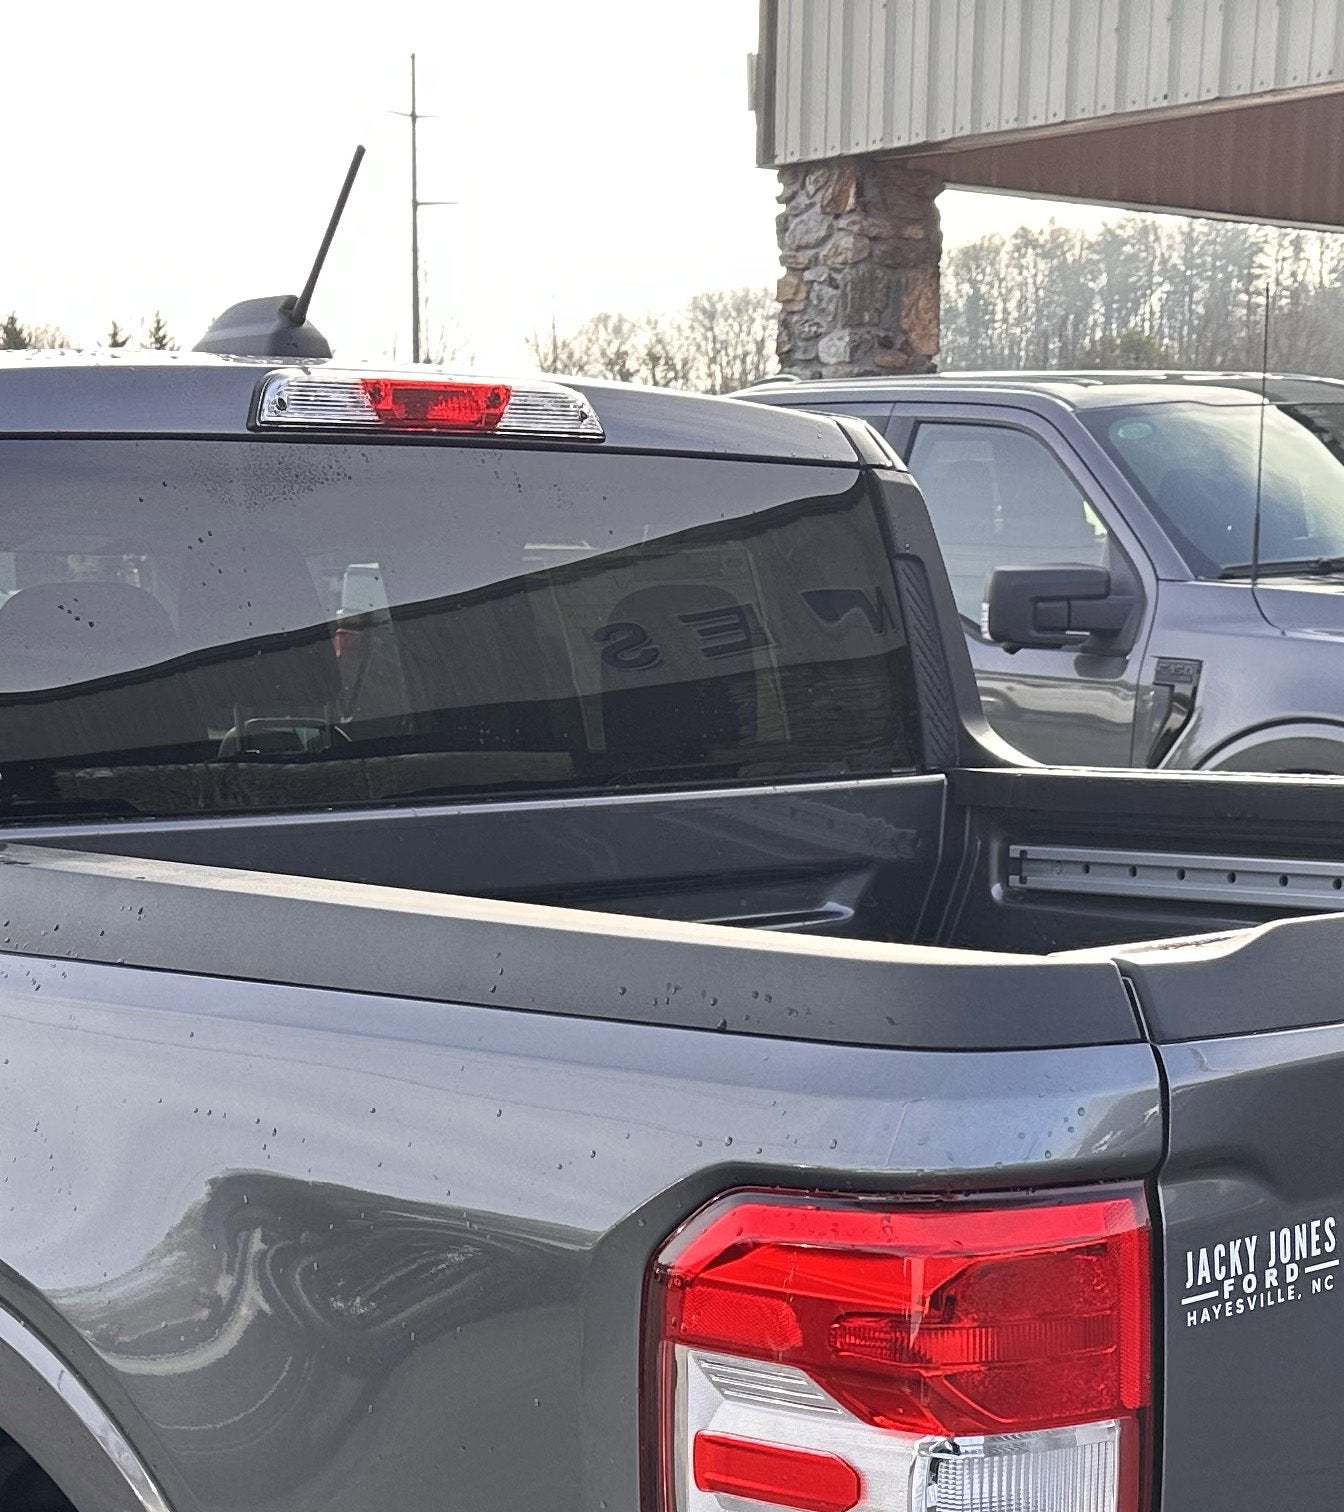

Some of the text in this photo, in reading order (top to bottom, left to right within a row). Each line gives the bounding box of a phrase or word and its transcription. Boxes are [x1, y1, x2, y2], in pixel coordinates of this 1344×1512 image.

[1185, 1216, 1337, 1289] JACKY JONES
[1186, 1274, 1335, 1328] HAYESVILLE, NC
[1223, 1262, 1300, 1300] FORD
